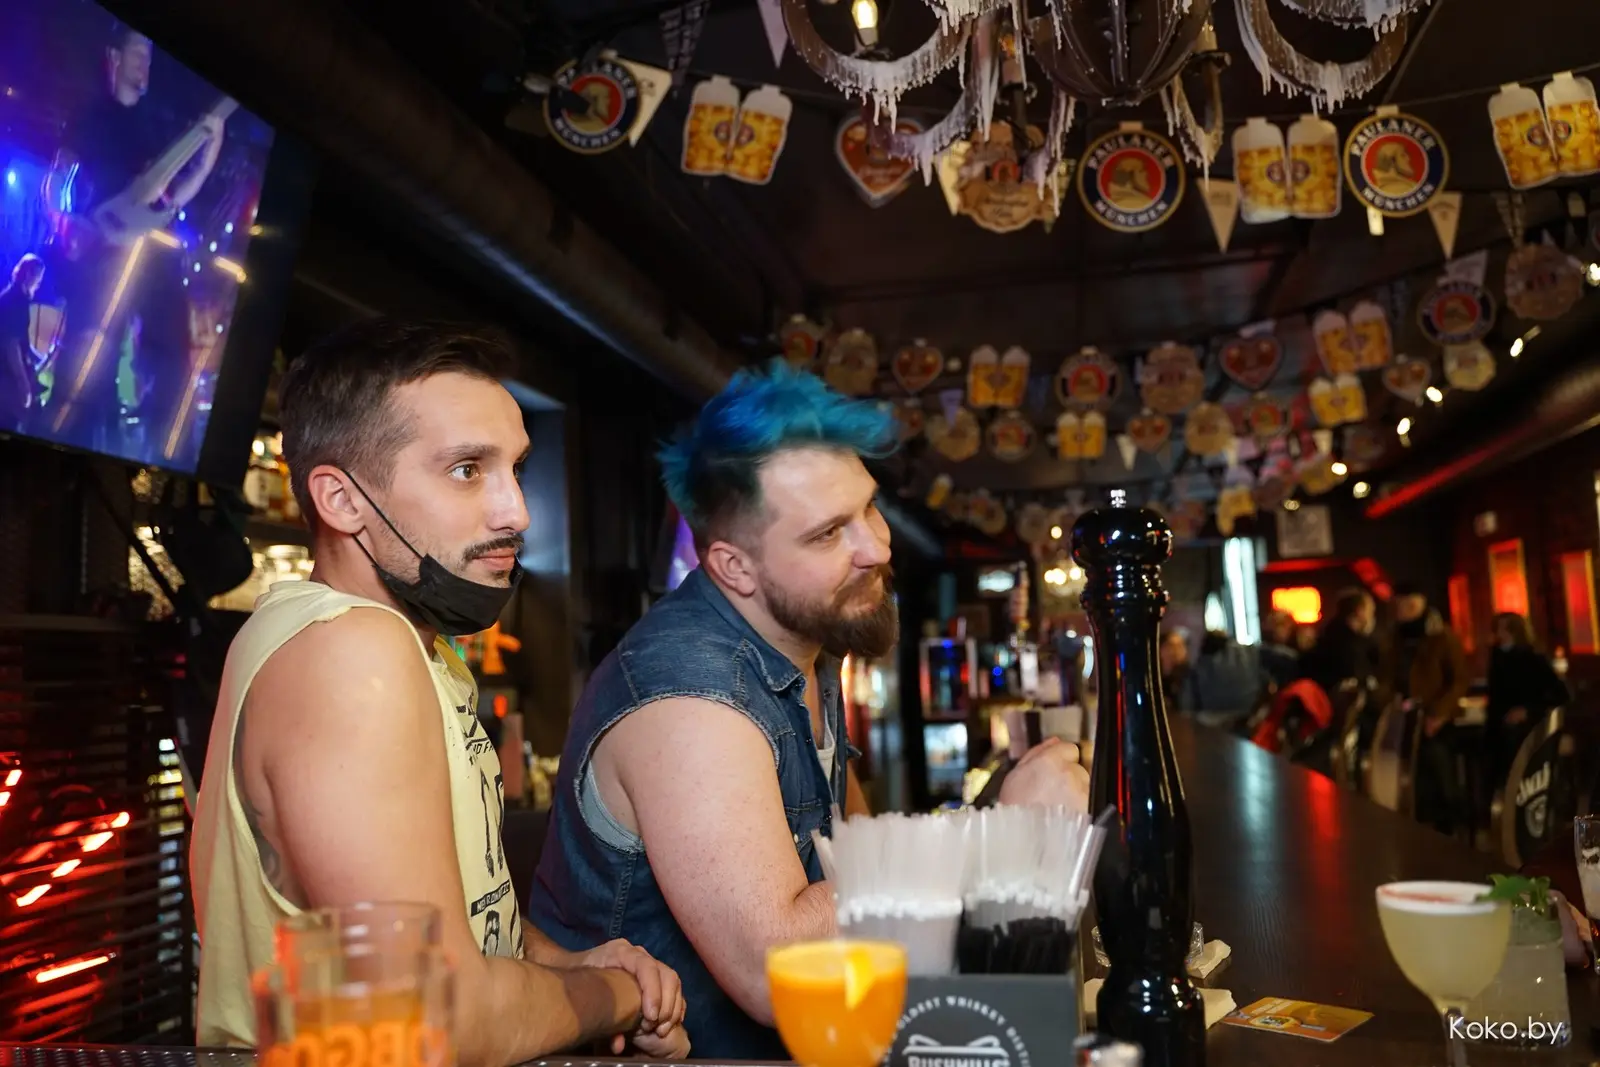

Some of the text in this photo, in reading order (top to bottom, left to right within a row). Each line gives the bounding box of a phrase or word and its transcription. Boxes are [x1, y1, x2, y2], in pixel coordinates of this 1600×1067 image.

[1086, 134, 1174, 168] PAULANER
[1350, 119, 1436, 156] PAULANER
[945, 995, 1006, 1026] WHISKEY
